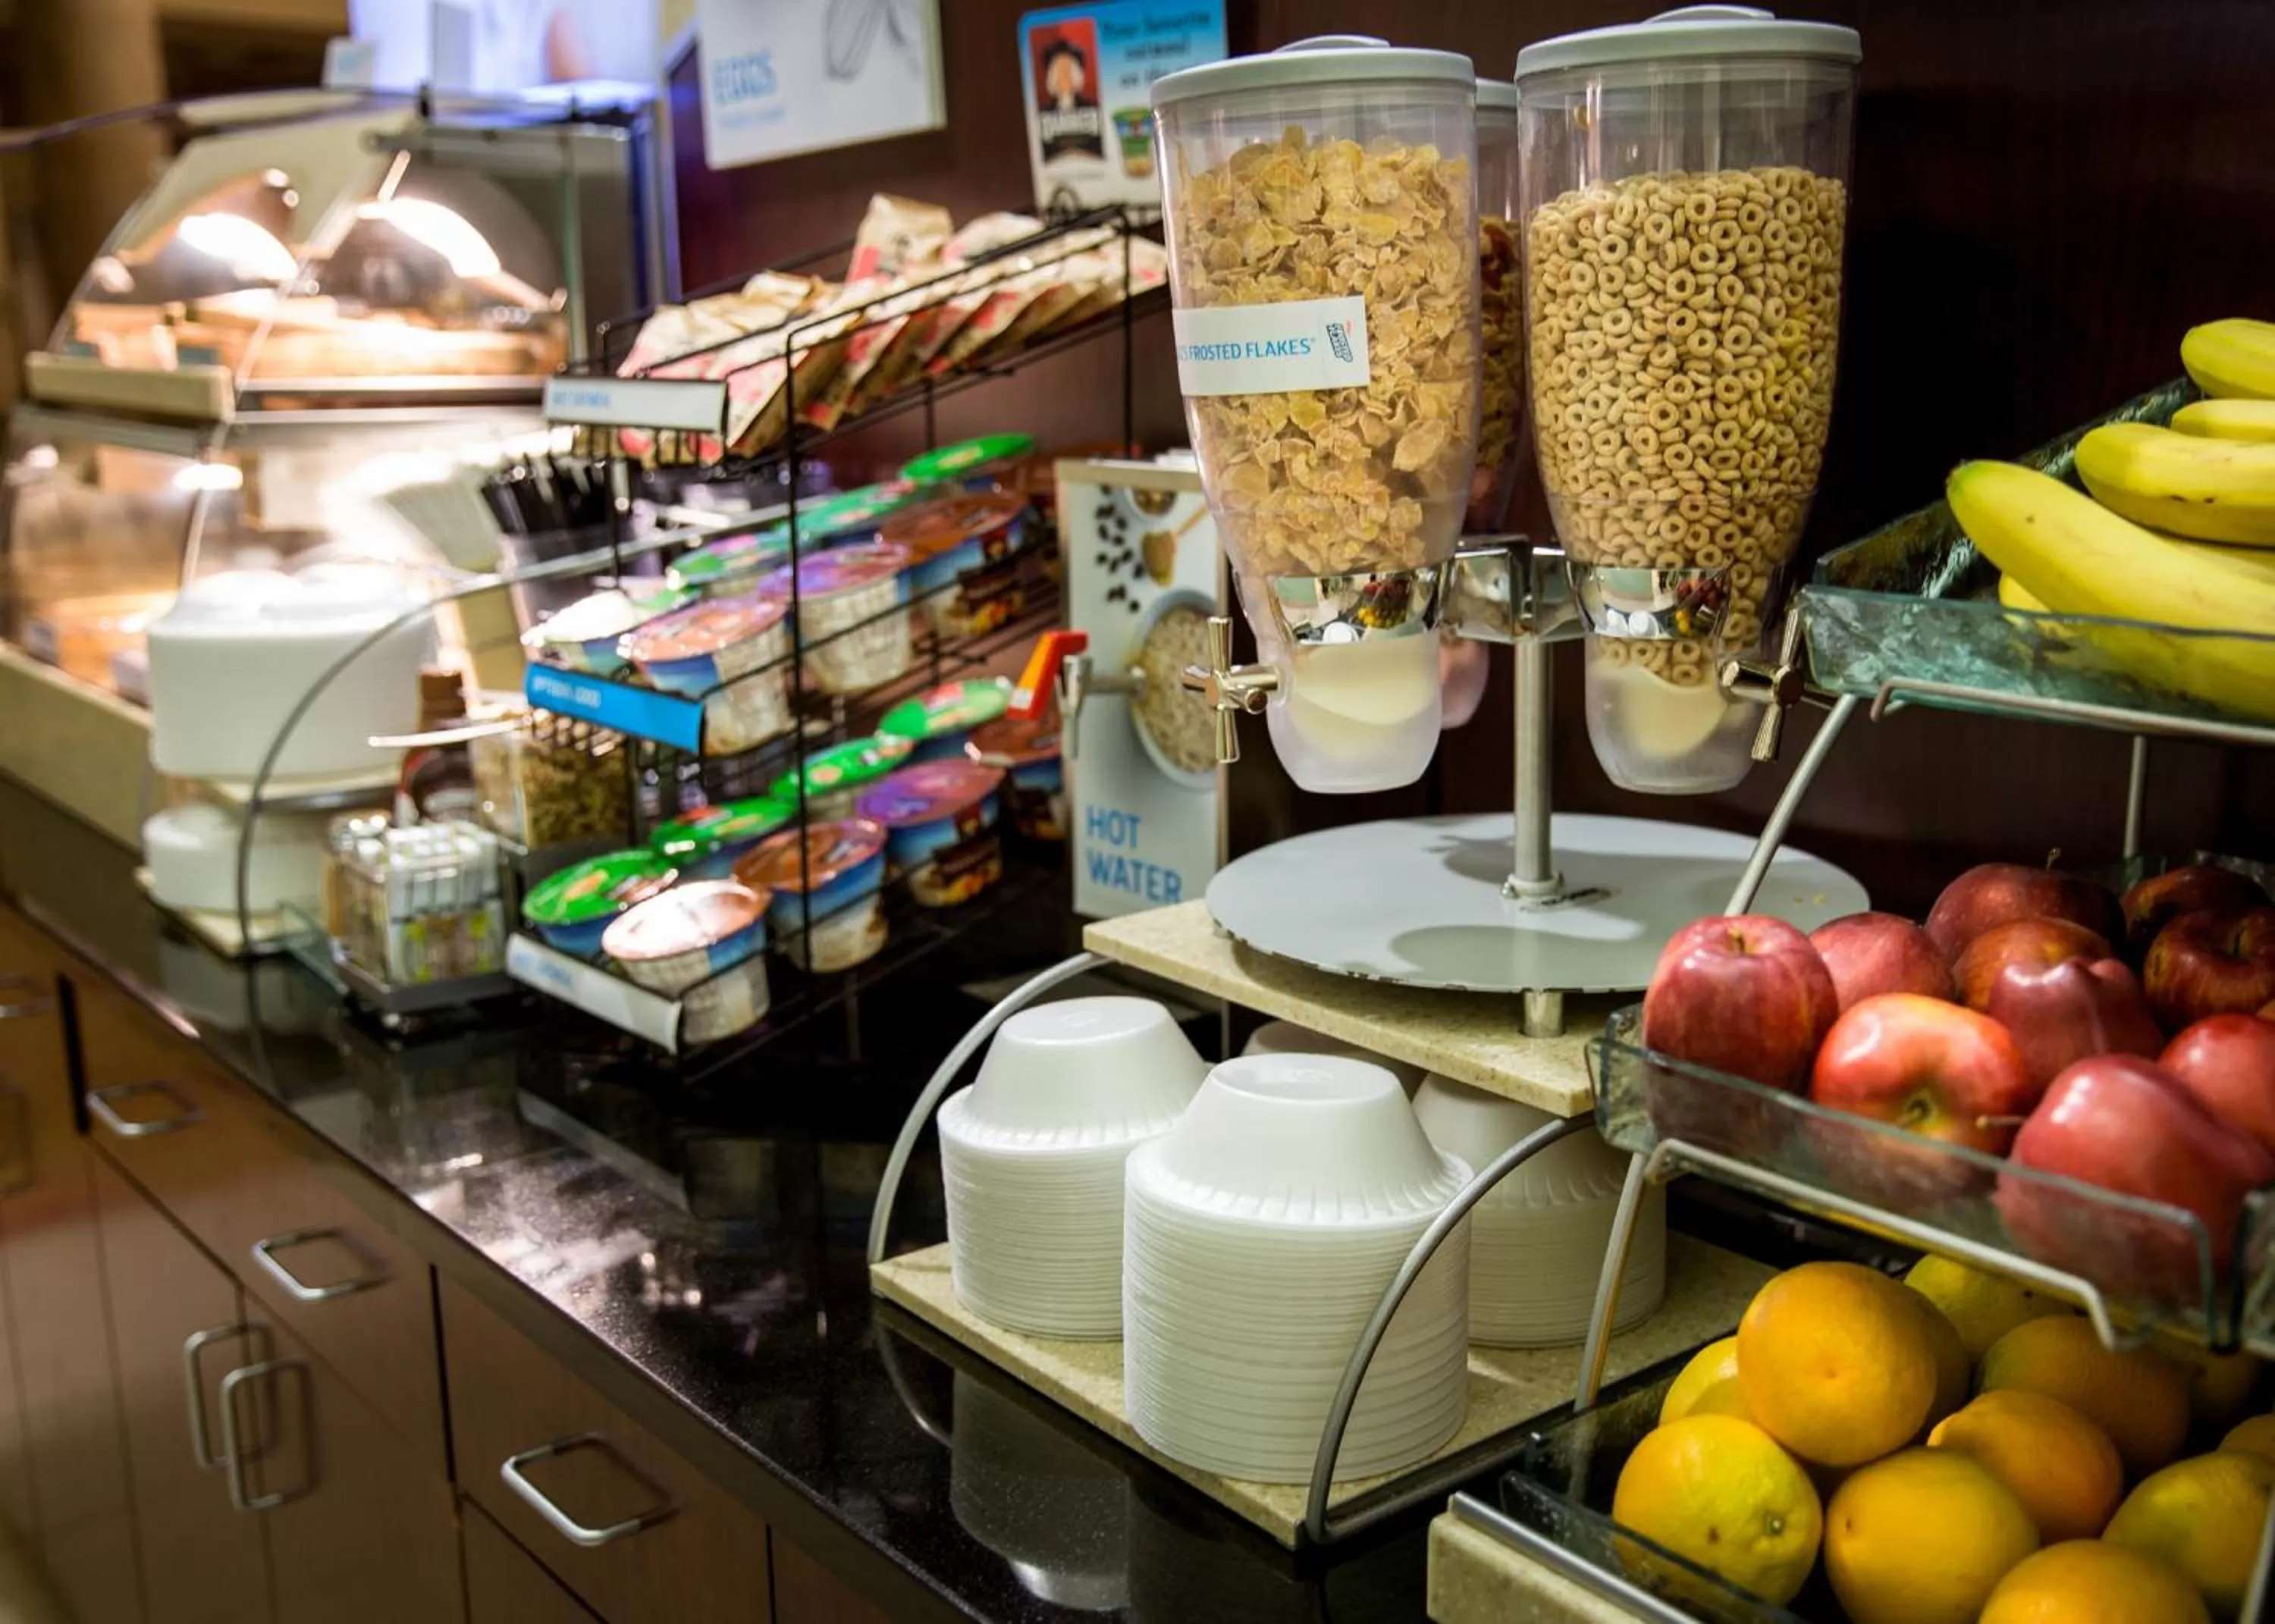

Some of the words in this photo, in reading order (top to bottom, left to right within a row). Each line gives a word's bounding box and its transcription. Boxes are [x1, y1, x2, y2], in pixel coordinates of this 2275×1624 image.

[1188, 343, 1241, 362] FROSTED
[1086, 804, 1141, 849] HOT
[1085, 846, 1182, 903] WATER
